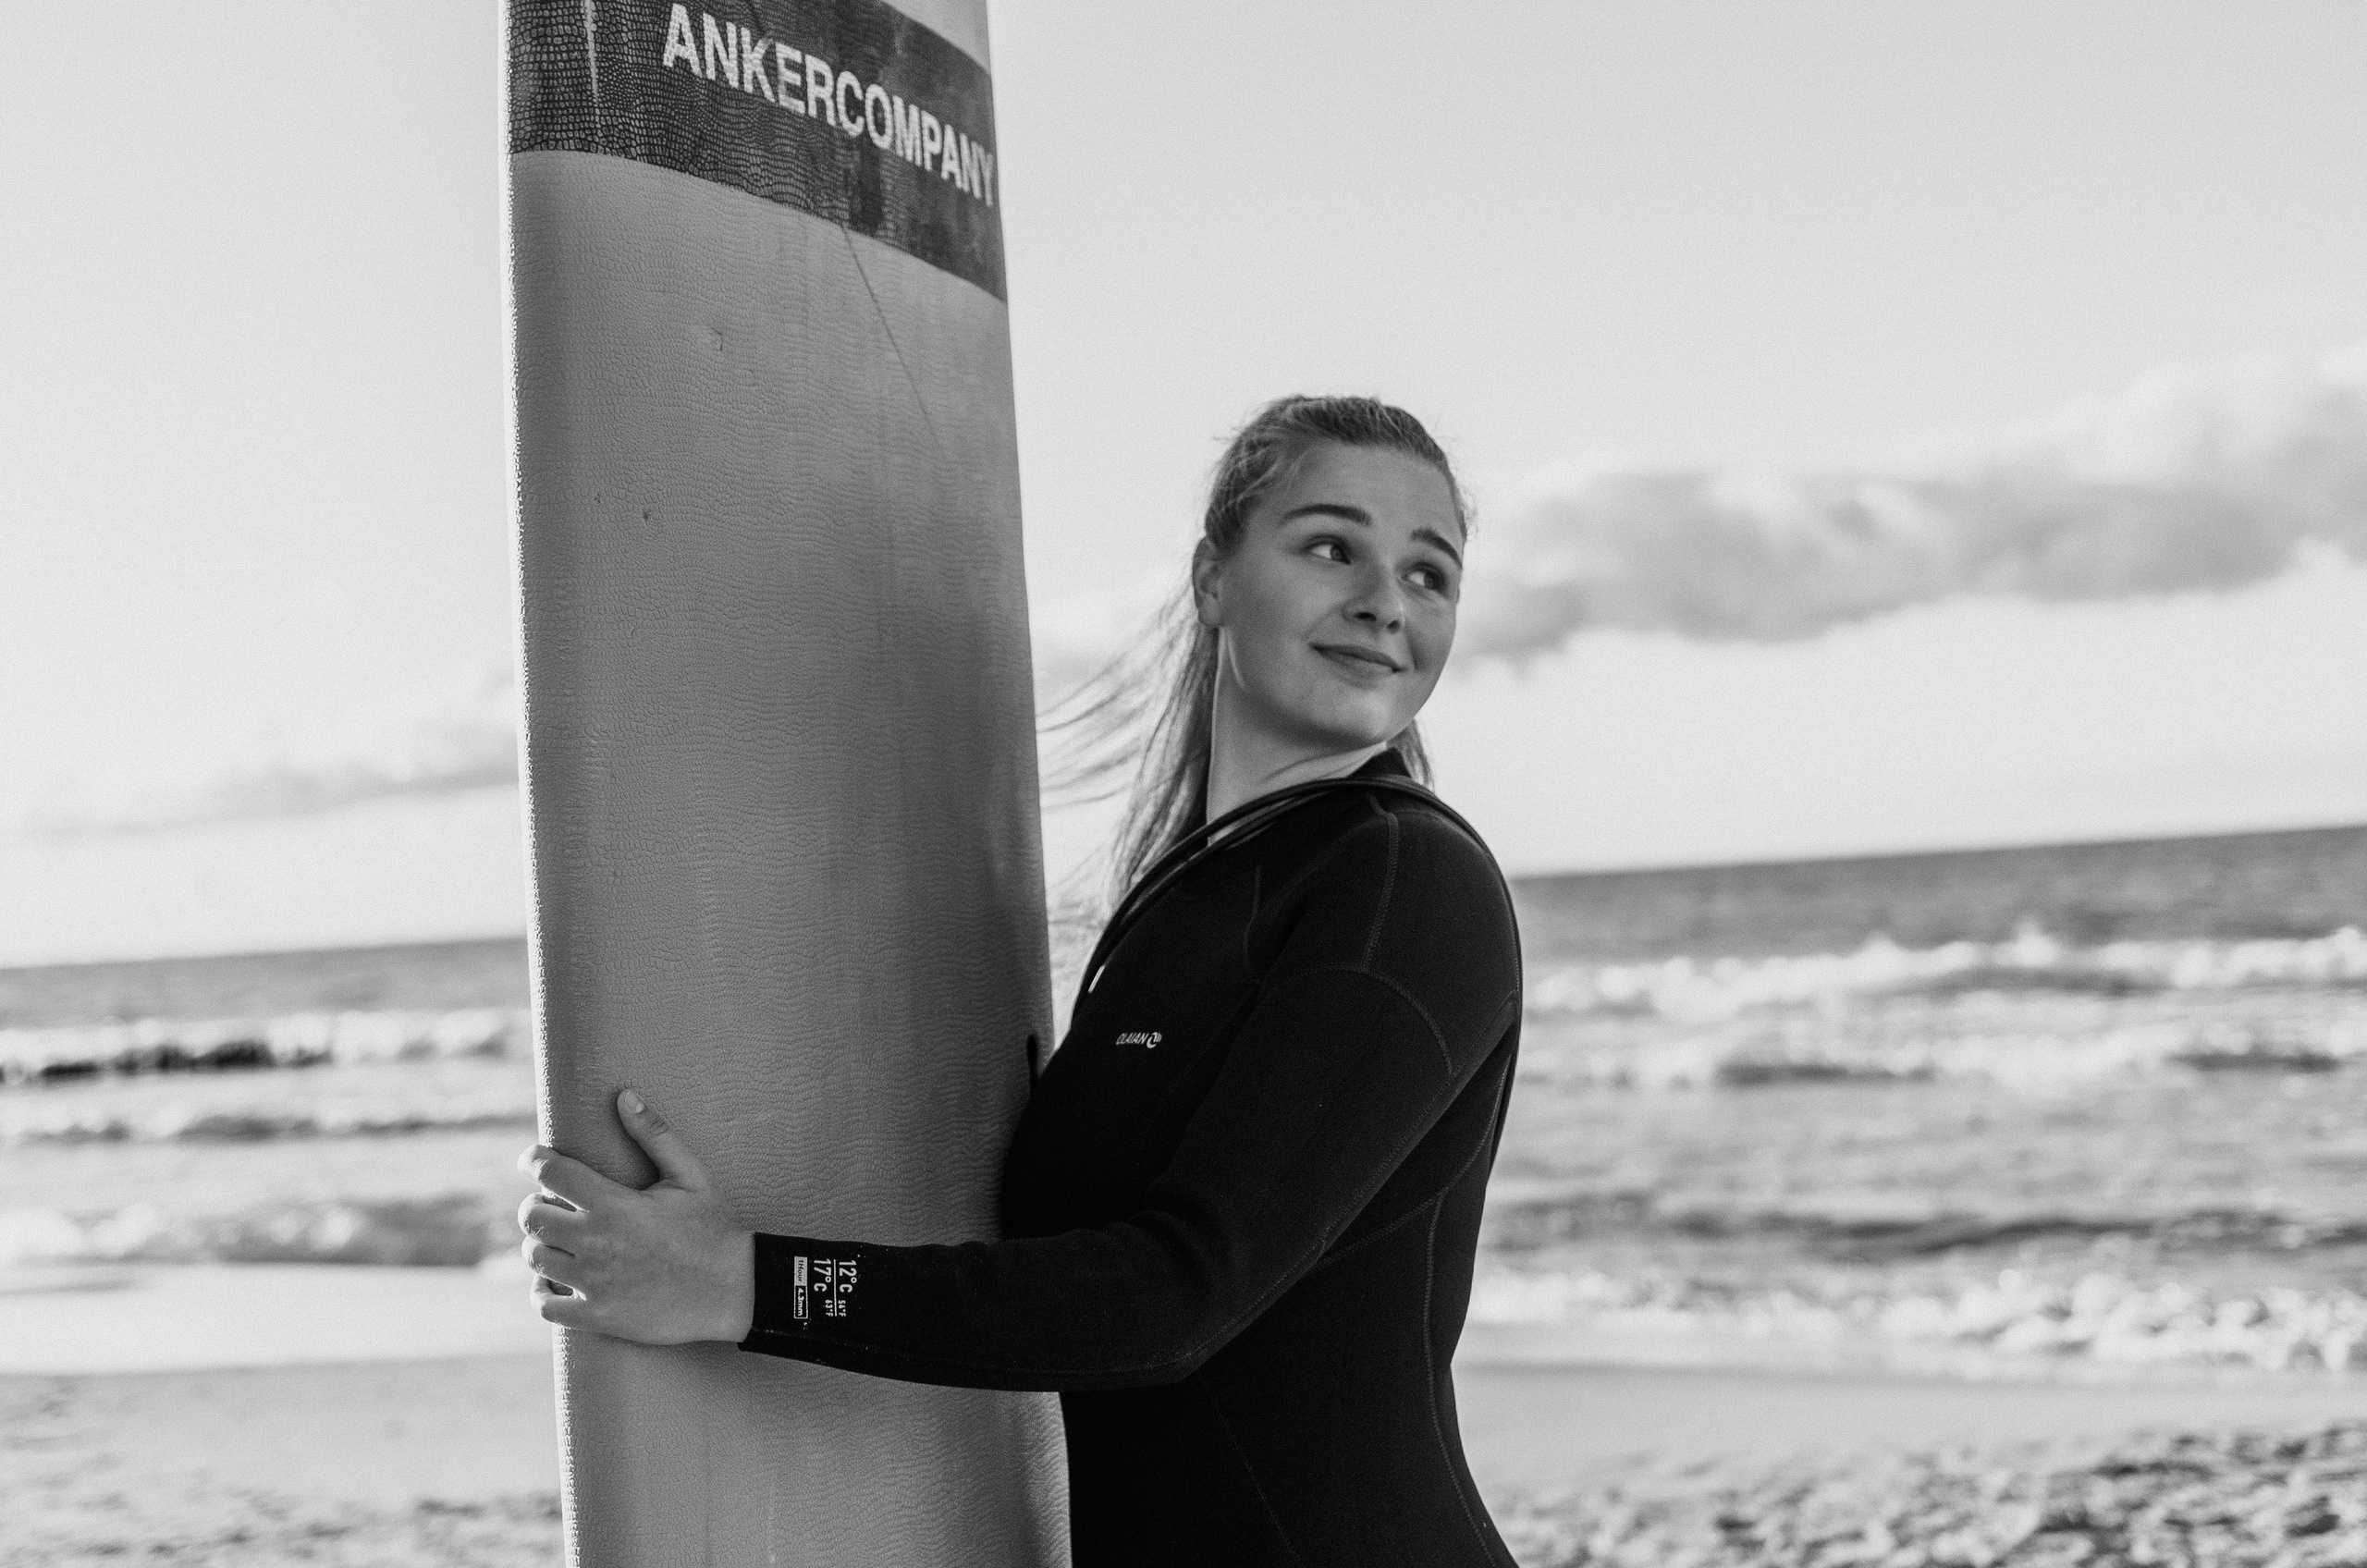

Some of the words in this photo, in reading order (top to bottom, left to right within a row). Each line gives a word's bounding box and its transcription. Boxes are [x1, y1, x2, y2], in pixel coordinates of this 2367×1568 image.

[663, 3, 994, 208] ANKERCOMPANY
[814, 1258, 832, 1292] 17°C
[839, 1259, 857, 1292] 12°C
